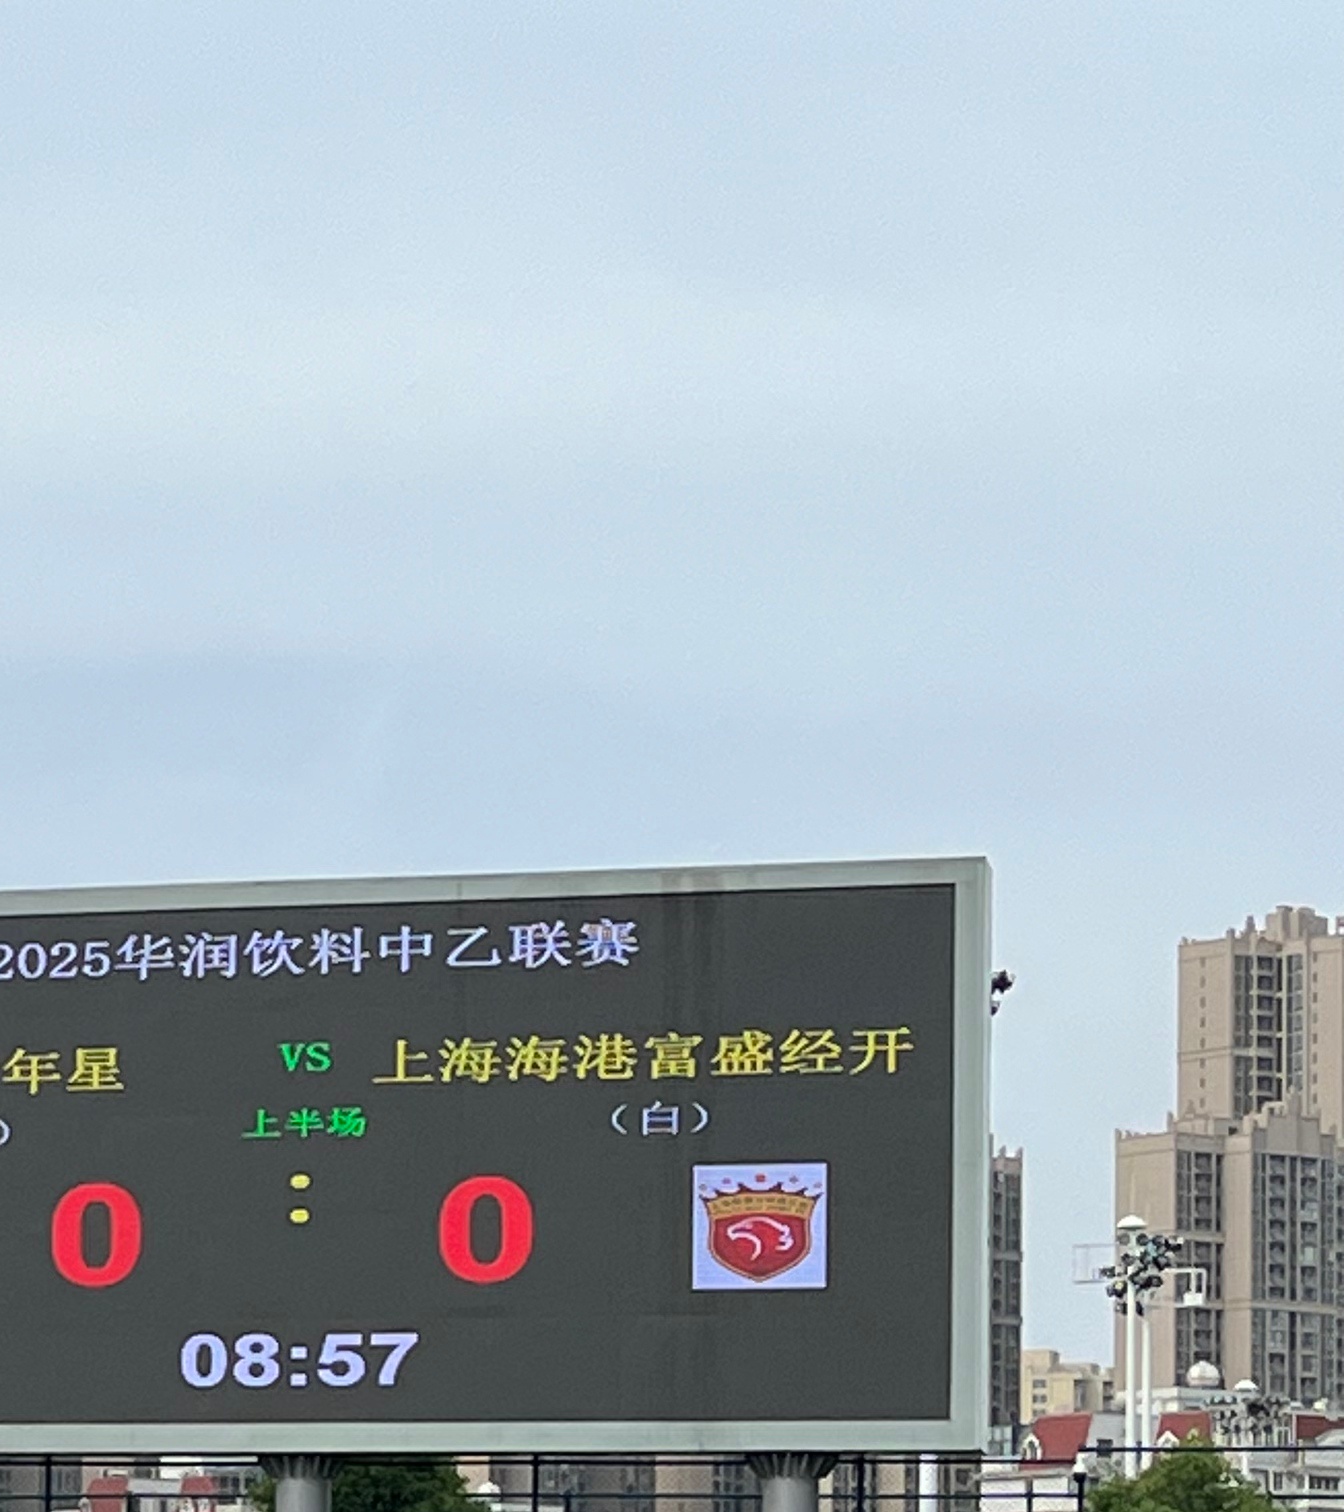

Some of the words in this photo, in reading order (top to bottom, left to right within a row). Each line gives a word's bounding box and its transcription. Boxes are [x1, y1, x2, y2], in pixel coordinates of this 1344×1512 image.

[277, 1042, 333, 1073] VS
[372, 1027, 914, 1085] 上海海港富盛经开
[242, 1107, 367, 1139] 上半场
[52, 1181, 142, 1288] 0
[439, 1174, 533, 1284] 0
[180, 1332, 419, 1388] 08:57
